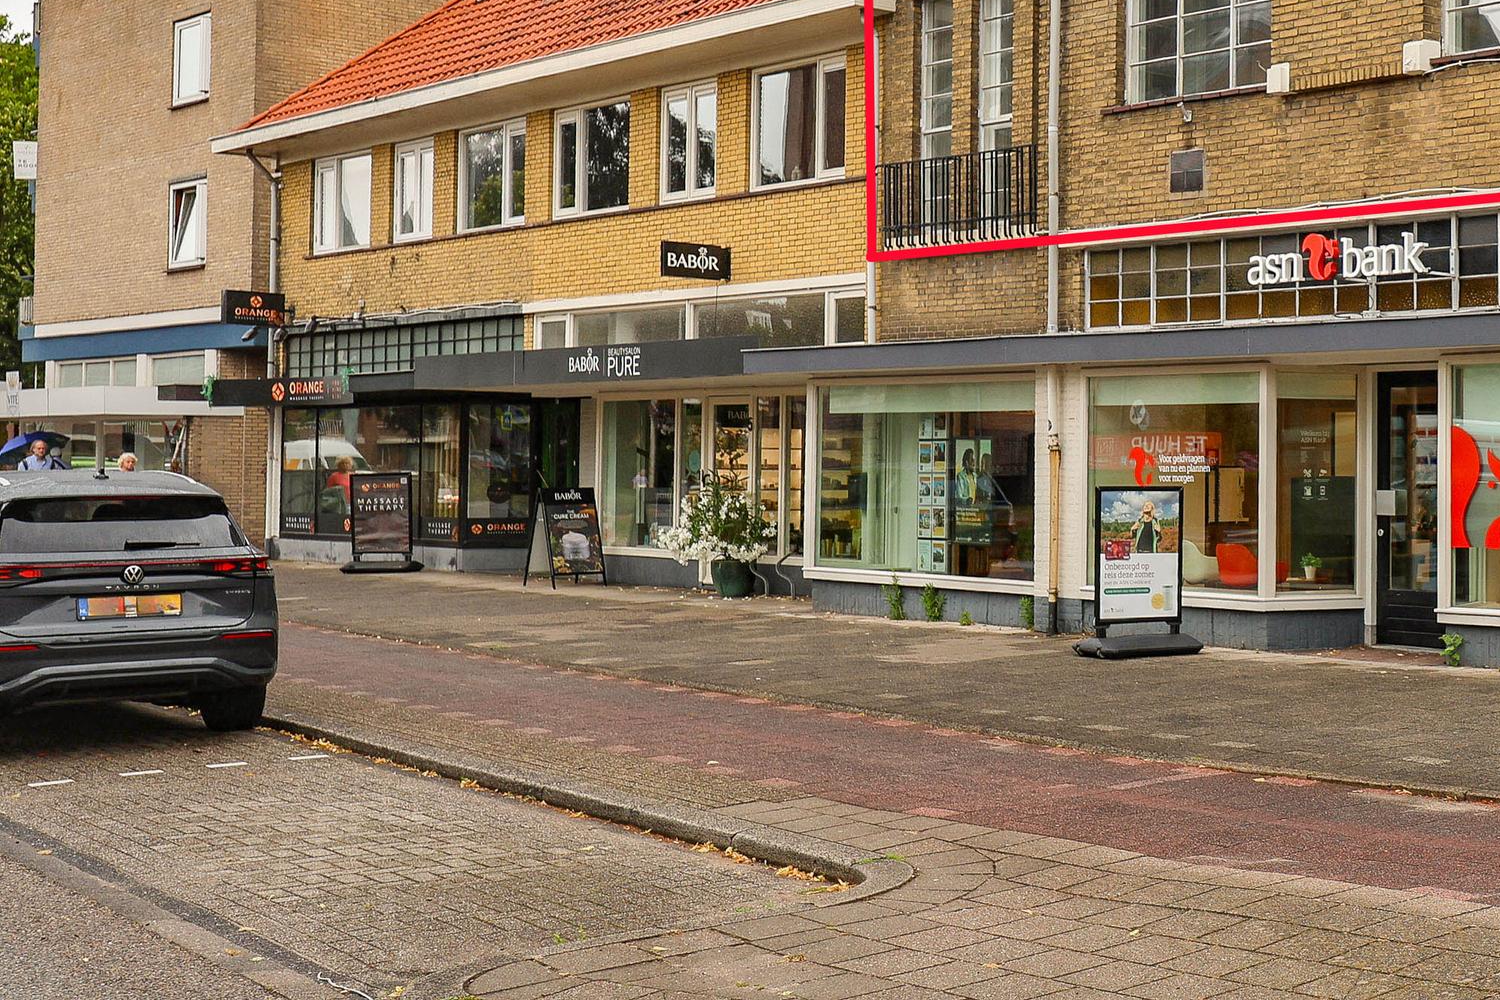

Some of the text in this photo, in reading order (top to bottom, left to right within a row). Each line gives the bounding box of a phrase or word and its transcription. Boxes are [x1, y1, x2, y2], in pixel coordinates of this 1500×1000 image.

[667, 247, 720, 273] BABOR
[1247, 231, 1431, 286] asn bank
[234, 306, 278, 318] ORANGE
[607, 346, 641, 356] BEAUTYSALON
[568, 348, 600, 374] BABOR
[607, 355, 641, 377] PURE
[289, 381, 324, 395] ORANGE
[1158, 453, 1206, 465] Voor geldvragen
[1158, 464, 1211, 475] van nu en plannen
[1158, 475, 1195, 485] voor morgen
[554, 489, 582, 501] BABOR
[358, 504, 405, 512] THERAPY
[487, 523, 526, 531] ORANGE
[1104, 563, 1150, 572] Onbezorgd op
[1104, 571, 1116, 579] reis
[1117, 571, 1134, 579] deze
